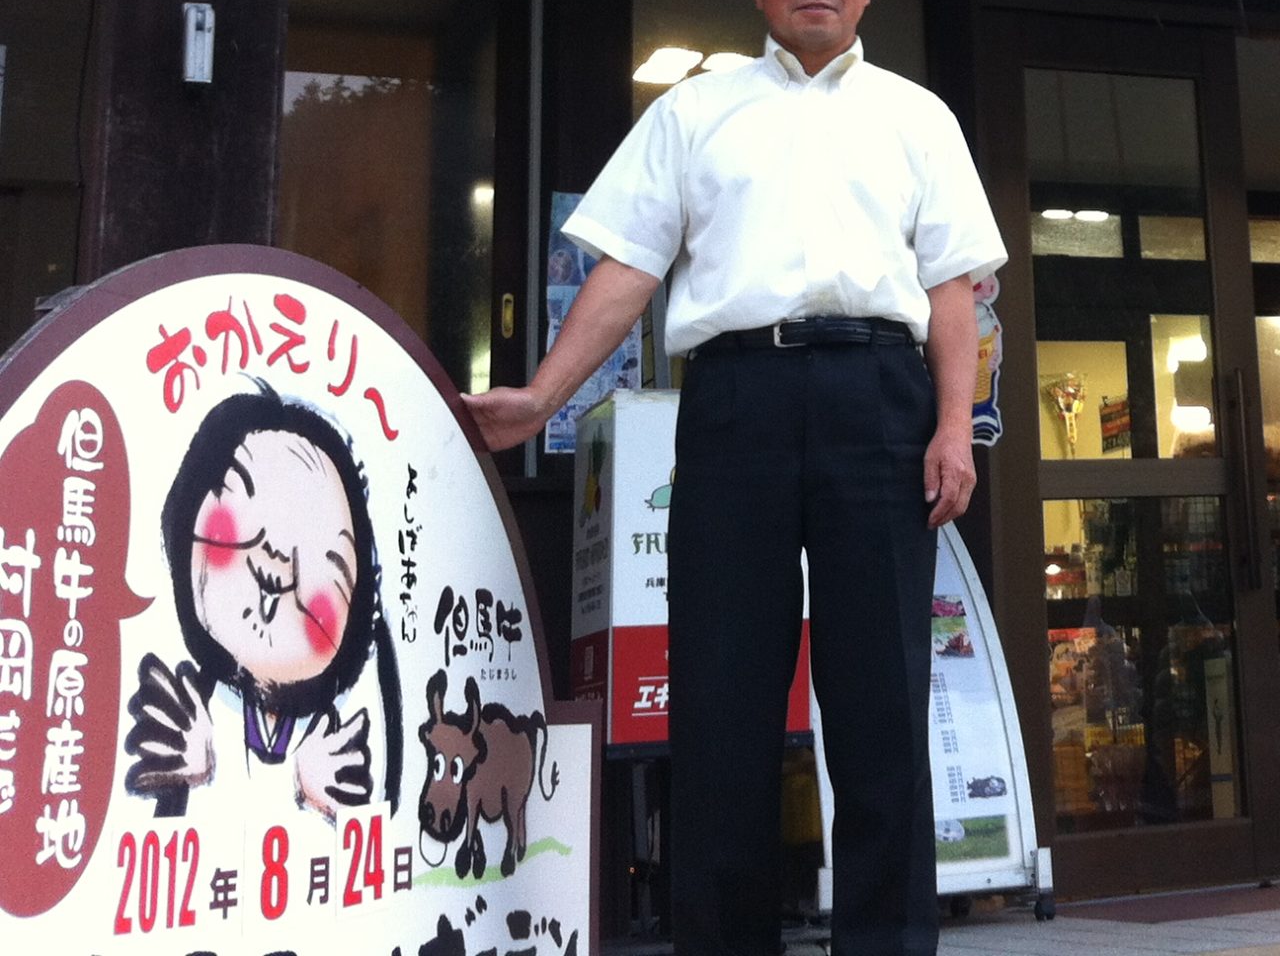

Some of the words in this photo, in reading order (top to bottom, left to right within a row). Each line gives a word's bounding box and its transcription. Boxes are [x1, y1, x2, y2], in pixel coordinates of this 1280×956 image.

[35, 406, 104, 869] 但馬牛の原産地
[434, 585, 523, 668] 但馬牛
[480, 668, 518, 682] たじまうし
